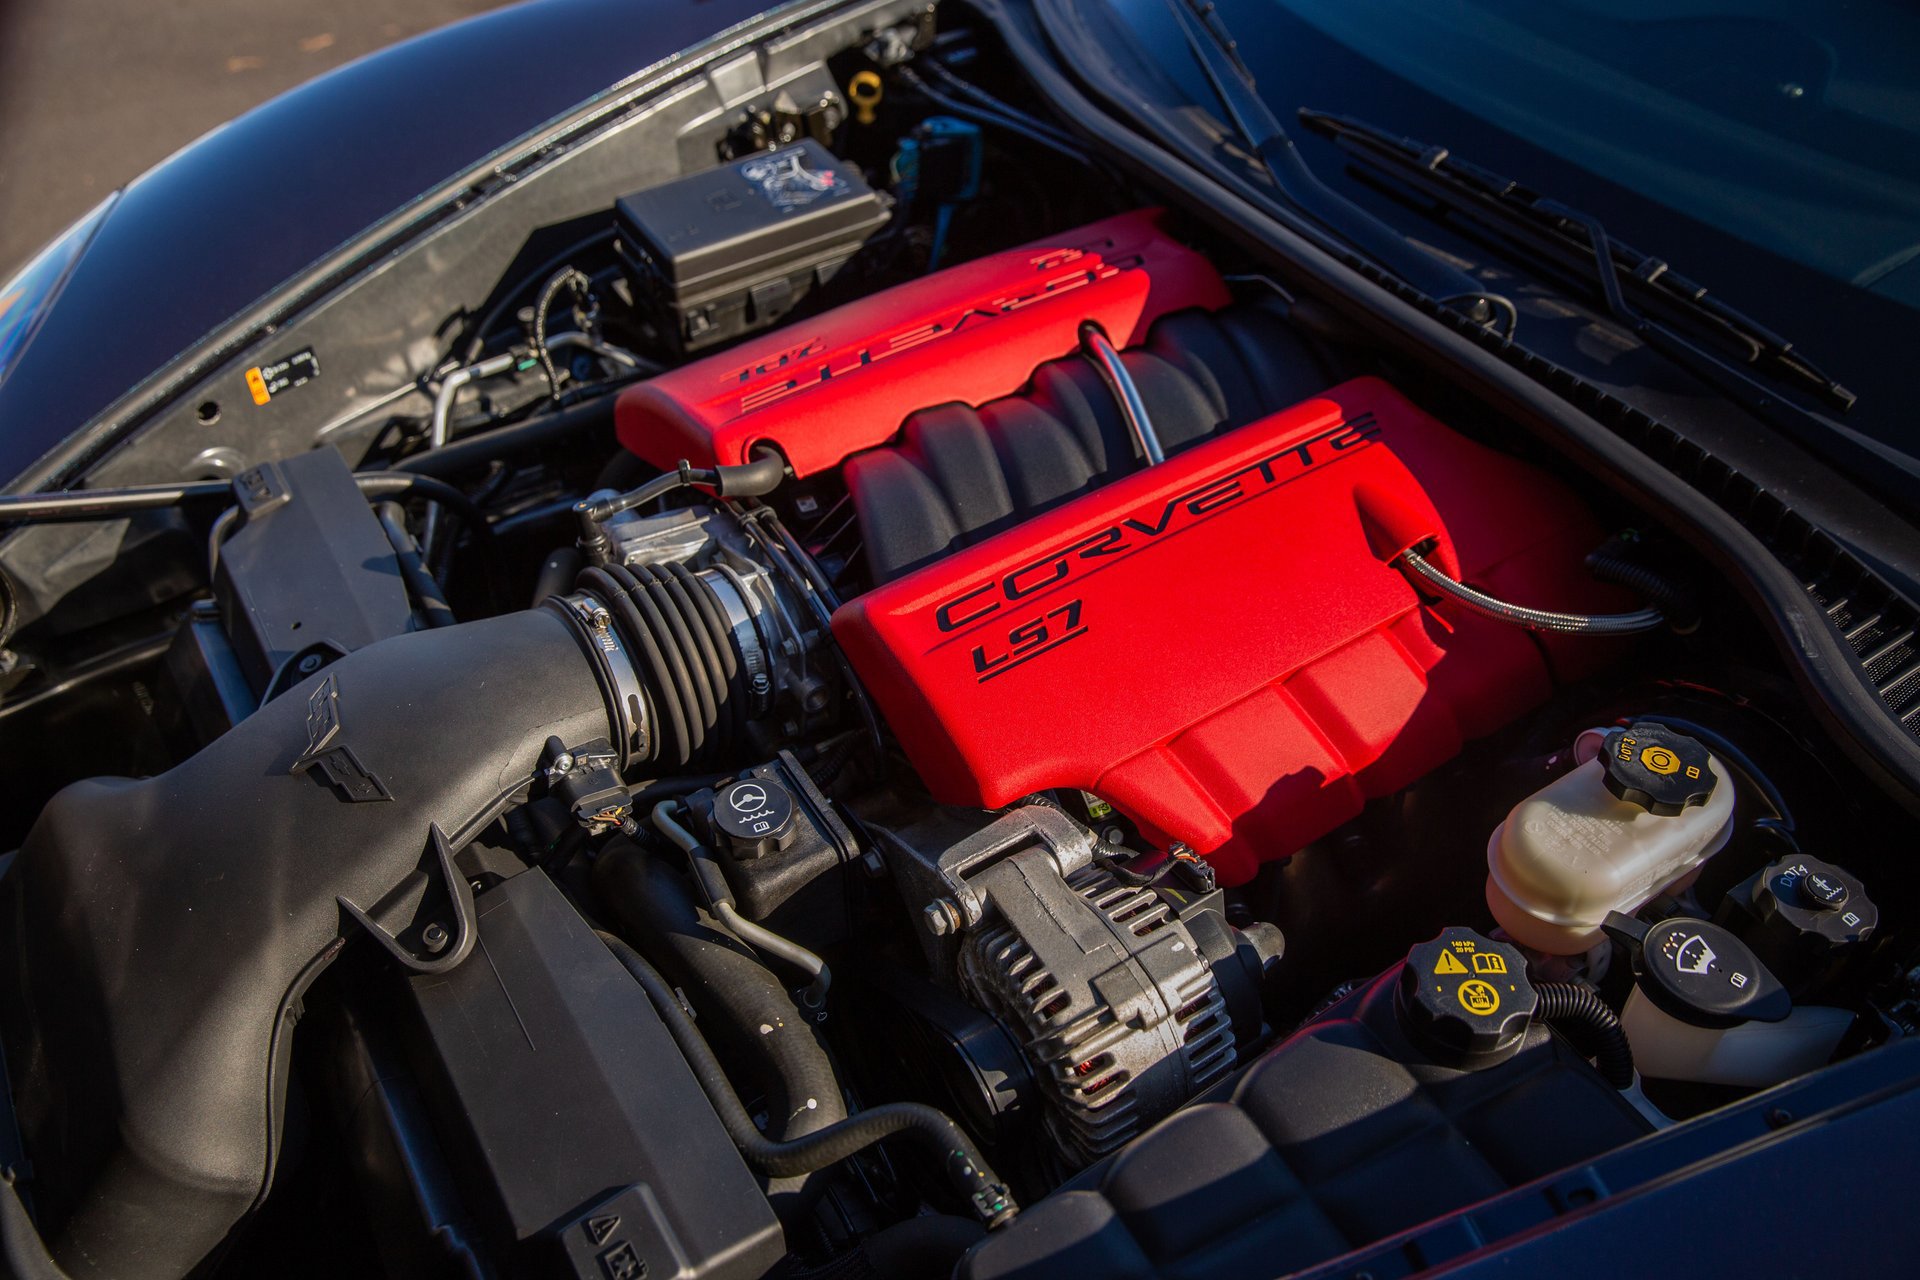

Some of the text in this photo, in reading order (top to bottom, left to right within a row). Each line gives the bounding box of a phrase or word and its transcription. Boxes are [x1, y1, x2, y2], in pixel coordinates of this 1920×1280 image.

[741, 253, 1145, 415] CORVETTE
[935, 410, 1382, 633] CORVETTE
[971, 599, 1084, 675] LS7
[1618, 737, 1637, 762] DOT 3
